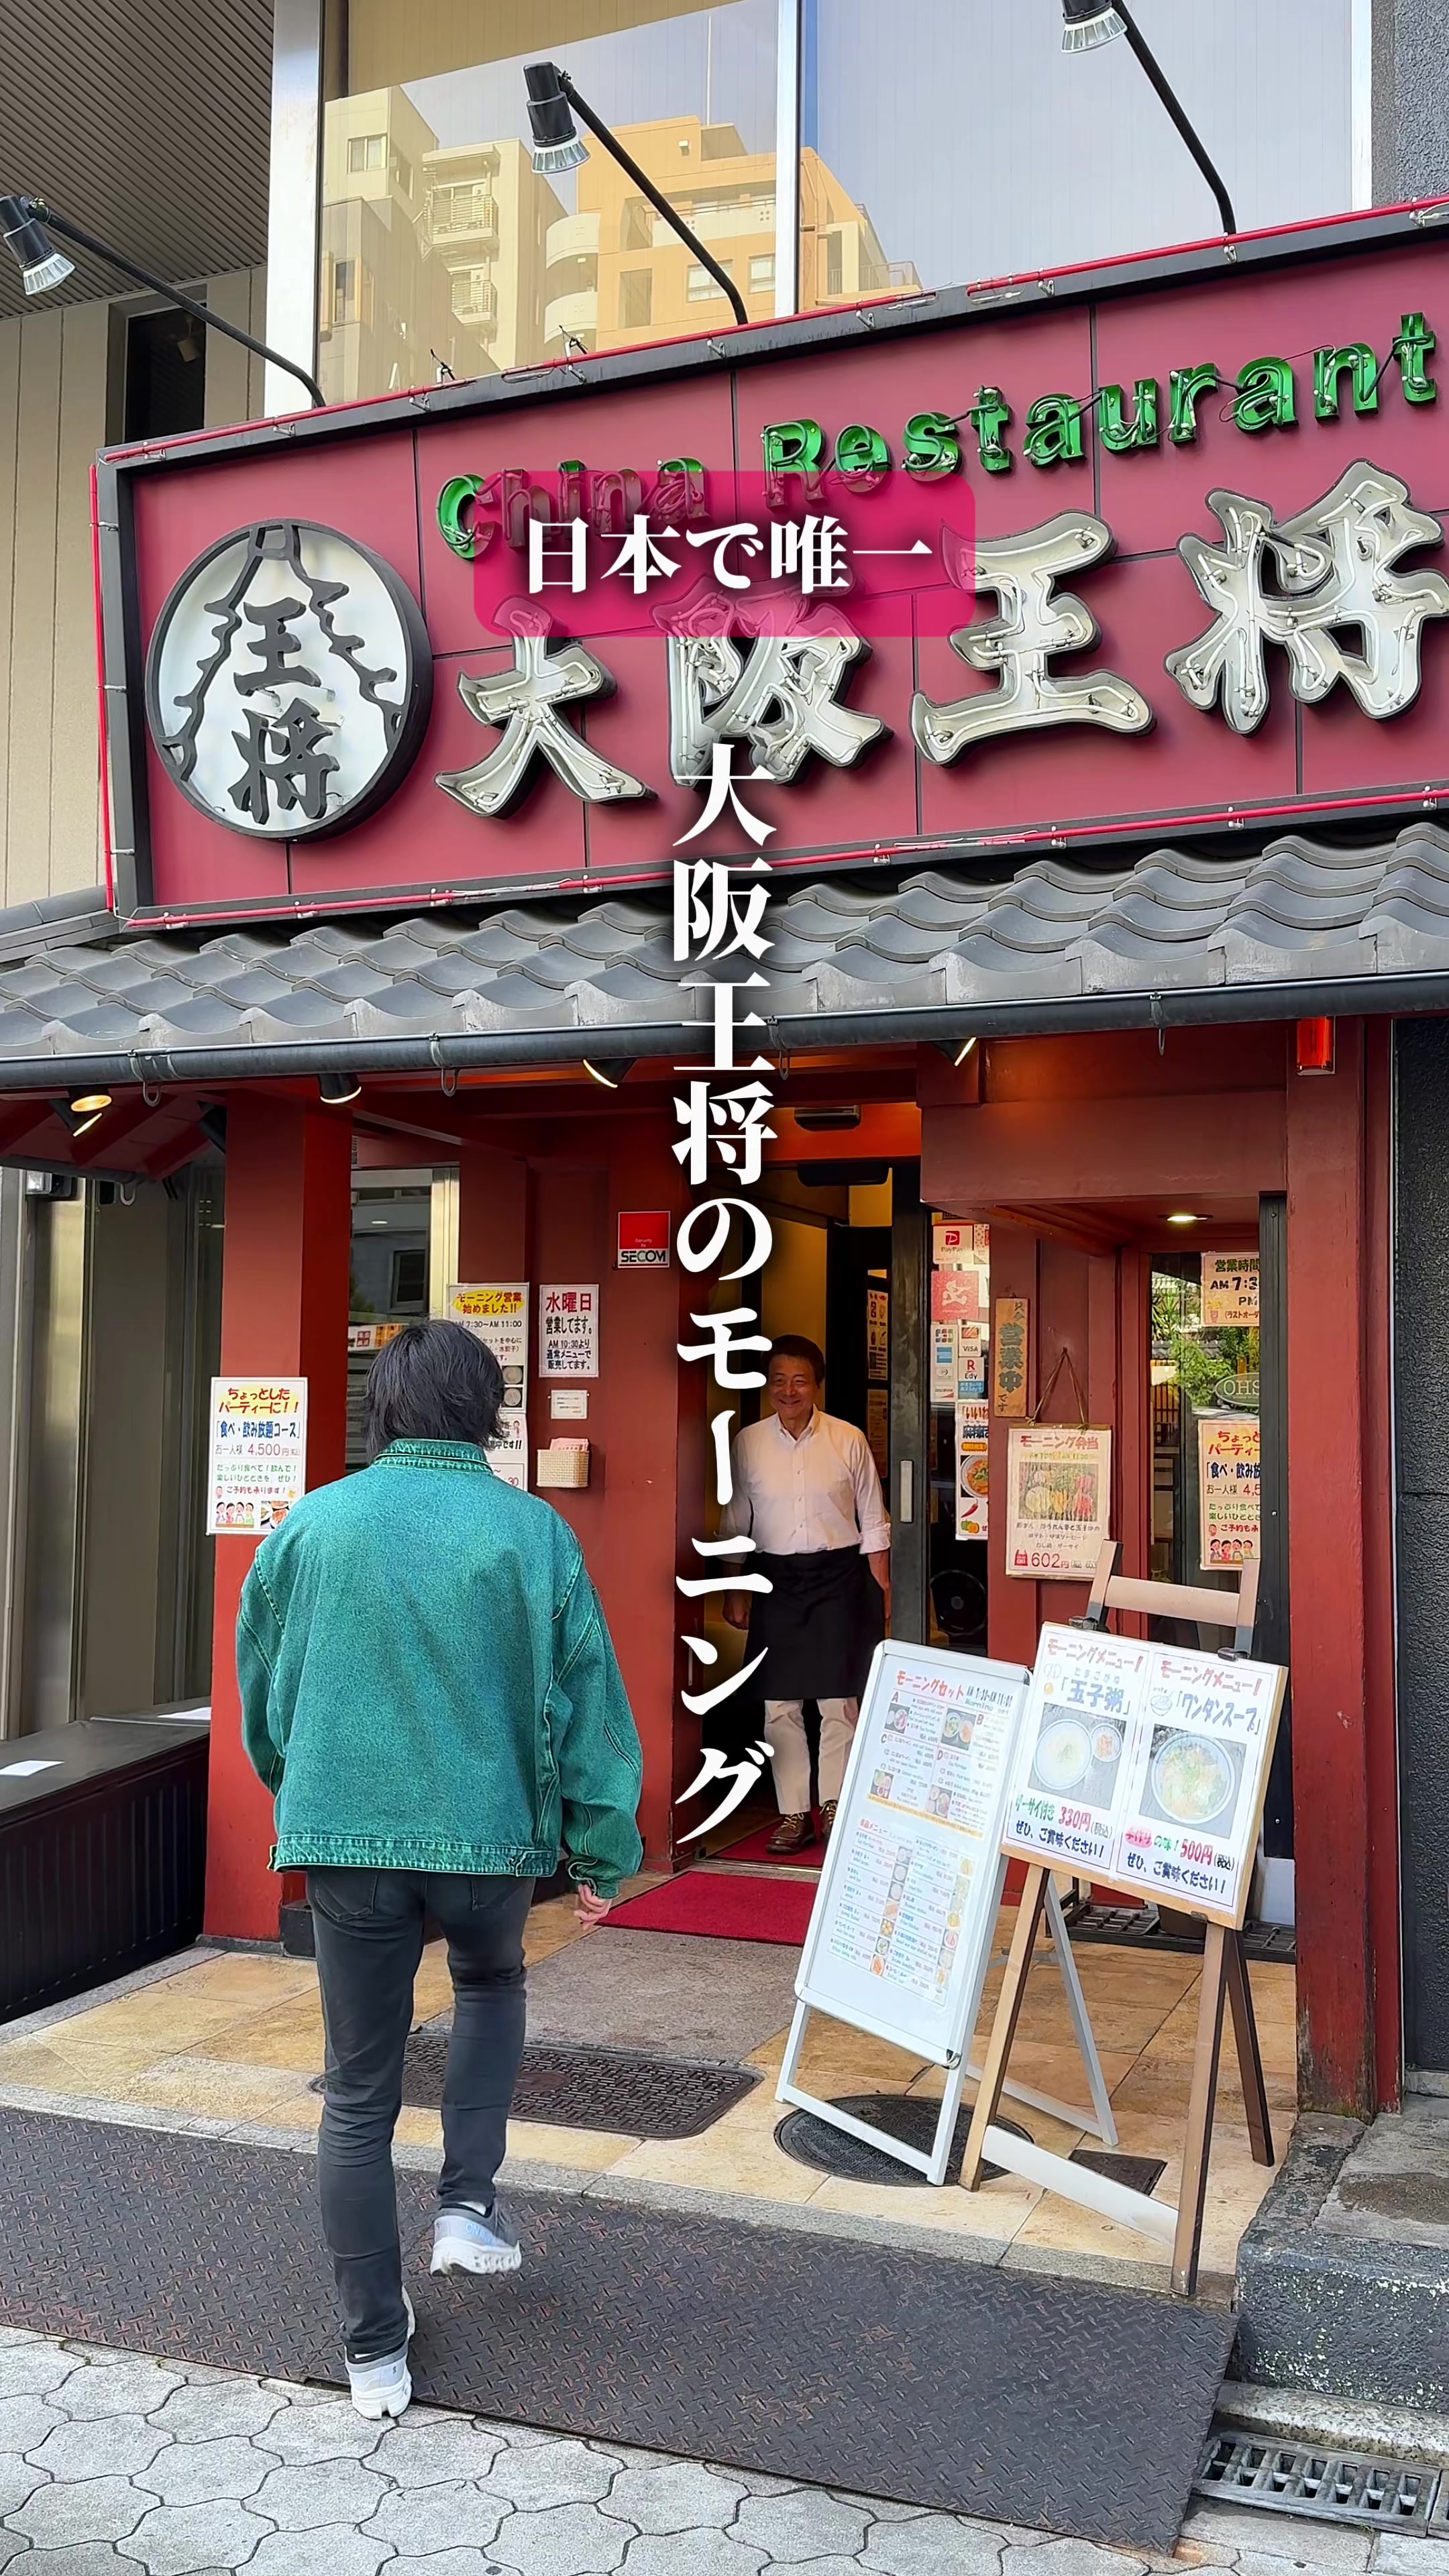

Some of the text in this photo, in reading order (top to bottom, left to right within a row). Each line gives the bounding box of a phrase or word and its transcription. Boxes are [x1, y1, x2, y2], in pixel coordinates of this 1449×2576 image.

[760, 311, 1436, 509] Restaurant
[435, 458, 1449, 818] 大阪王将
[621, 1250, 665, 1263] SECOM
[1215, 1258, 1260, 1272] 営業時間
[1210, 1281, 1229, 1289] AM
[457, 1292, 521, 1302] モーニング営業
[545, 1292, 591, 1313] 水曜日
[1238, 1296, 1257, 1305] PM
[546, 1316, 592, 1334] 営業してます。
[549, 1340, 558, 1348] AM
[547, 1350, 591, 1359] 通常メニューで
[998, 1323, 1024, 1393] 営業中
[228, 1387, 290, 1399] ちょっとした
[216, 1420, 301, 1439] 「食べ・飲み放題コース」
[1020, 1435, 1099, 1450] モーニング弁当
[1218, 1431, 1260, 1442] ちょっと
[215, 1444, 242, 1454] お一人様
[1207, 1484, 1238, 1494] お一人様
[1032, 1552, 1069, 1568] 602円
[896, 1670, 964, 1700] モーニングセット
[892, 1692, 899, 1703] A
[1177, 1690, 1261, 1735] 「ワンタンスープ」
[976, 1713, 984, 1725] B
[881, 1733, 888, 1743] C
[936, 1750, 943, 1761] D
